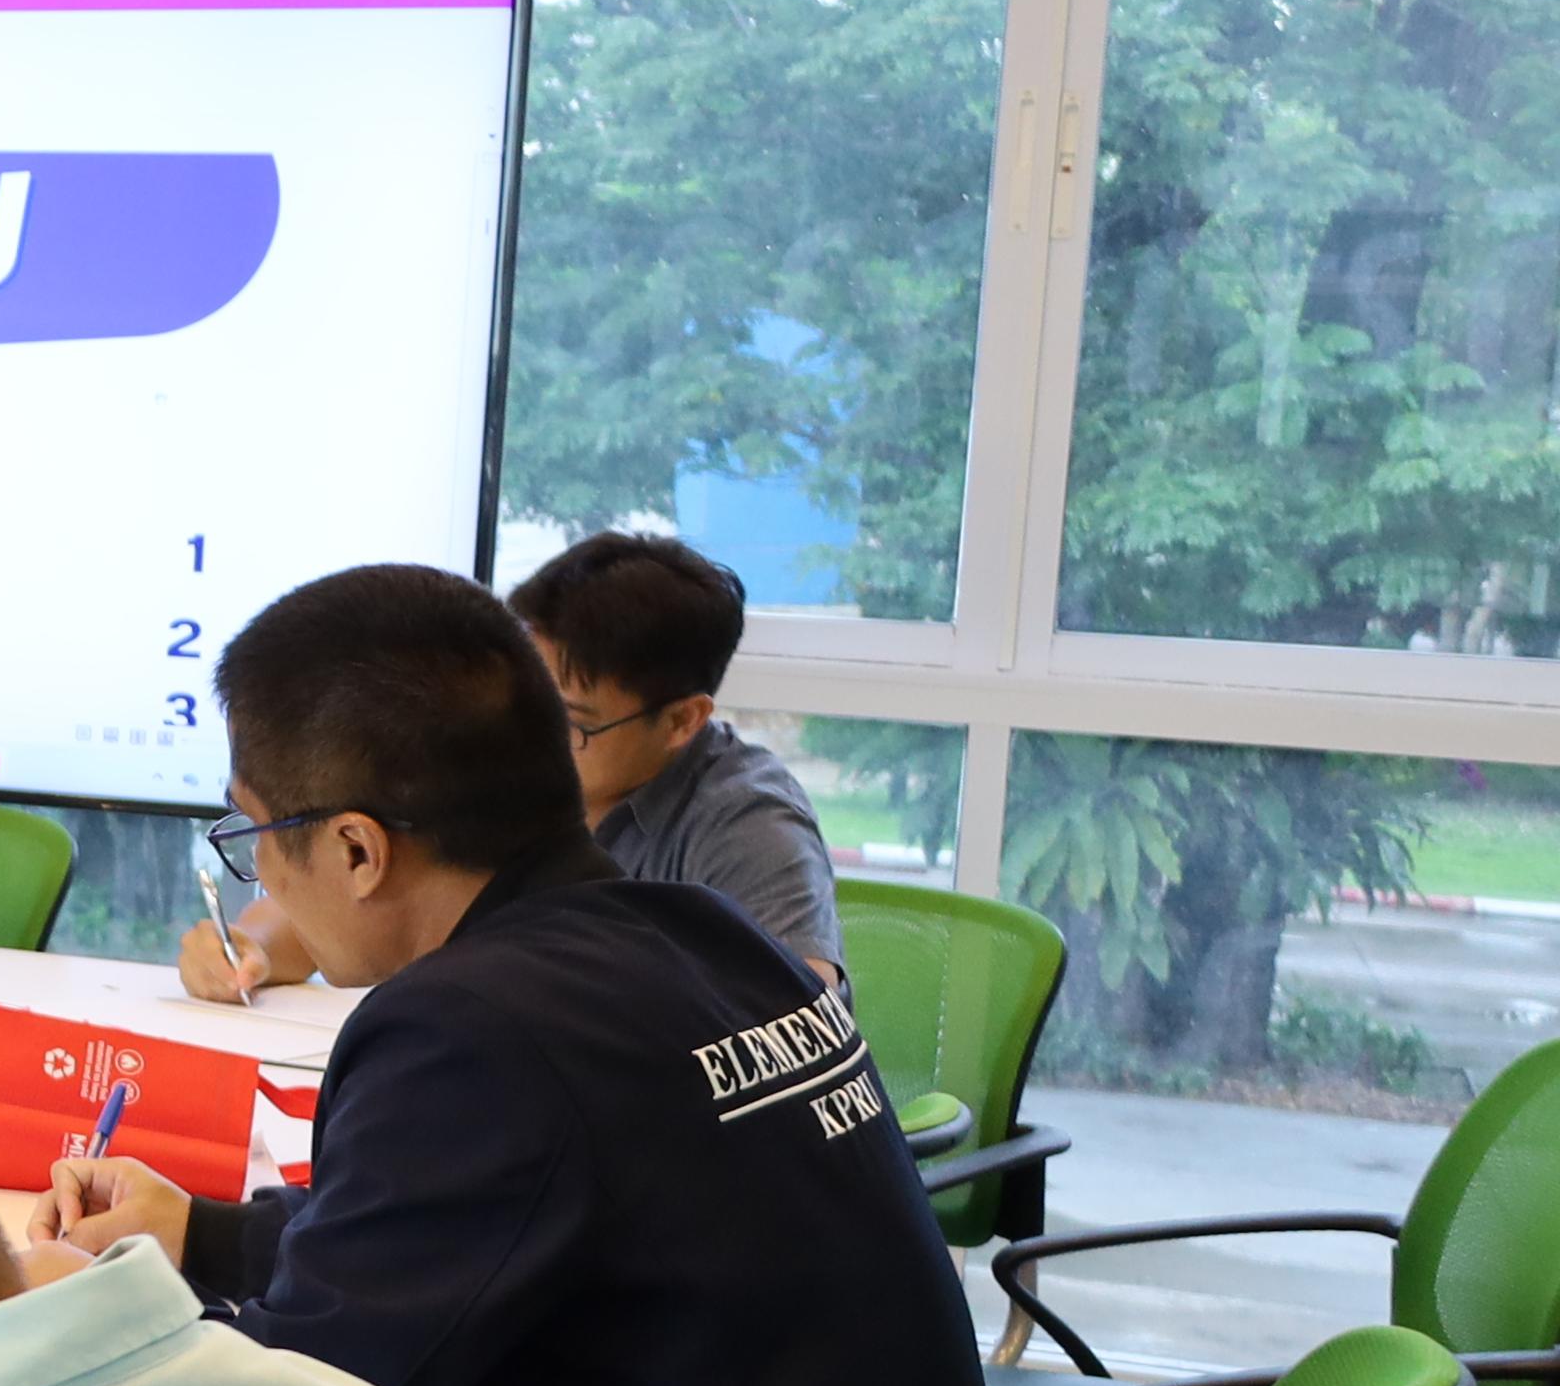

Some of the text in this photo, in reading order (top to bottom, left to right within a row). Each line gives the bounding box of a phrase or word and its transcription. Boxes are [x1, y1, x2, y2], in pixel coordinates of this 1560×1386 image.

[187, 534, 205, 573] 1
[166, 618, 202, 658] 2
[163, 693, 197, 726] 3
[808, 1070, 882, 1140] KPRU
